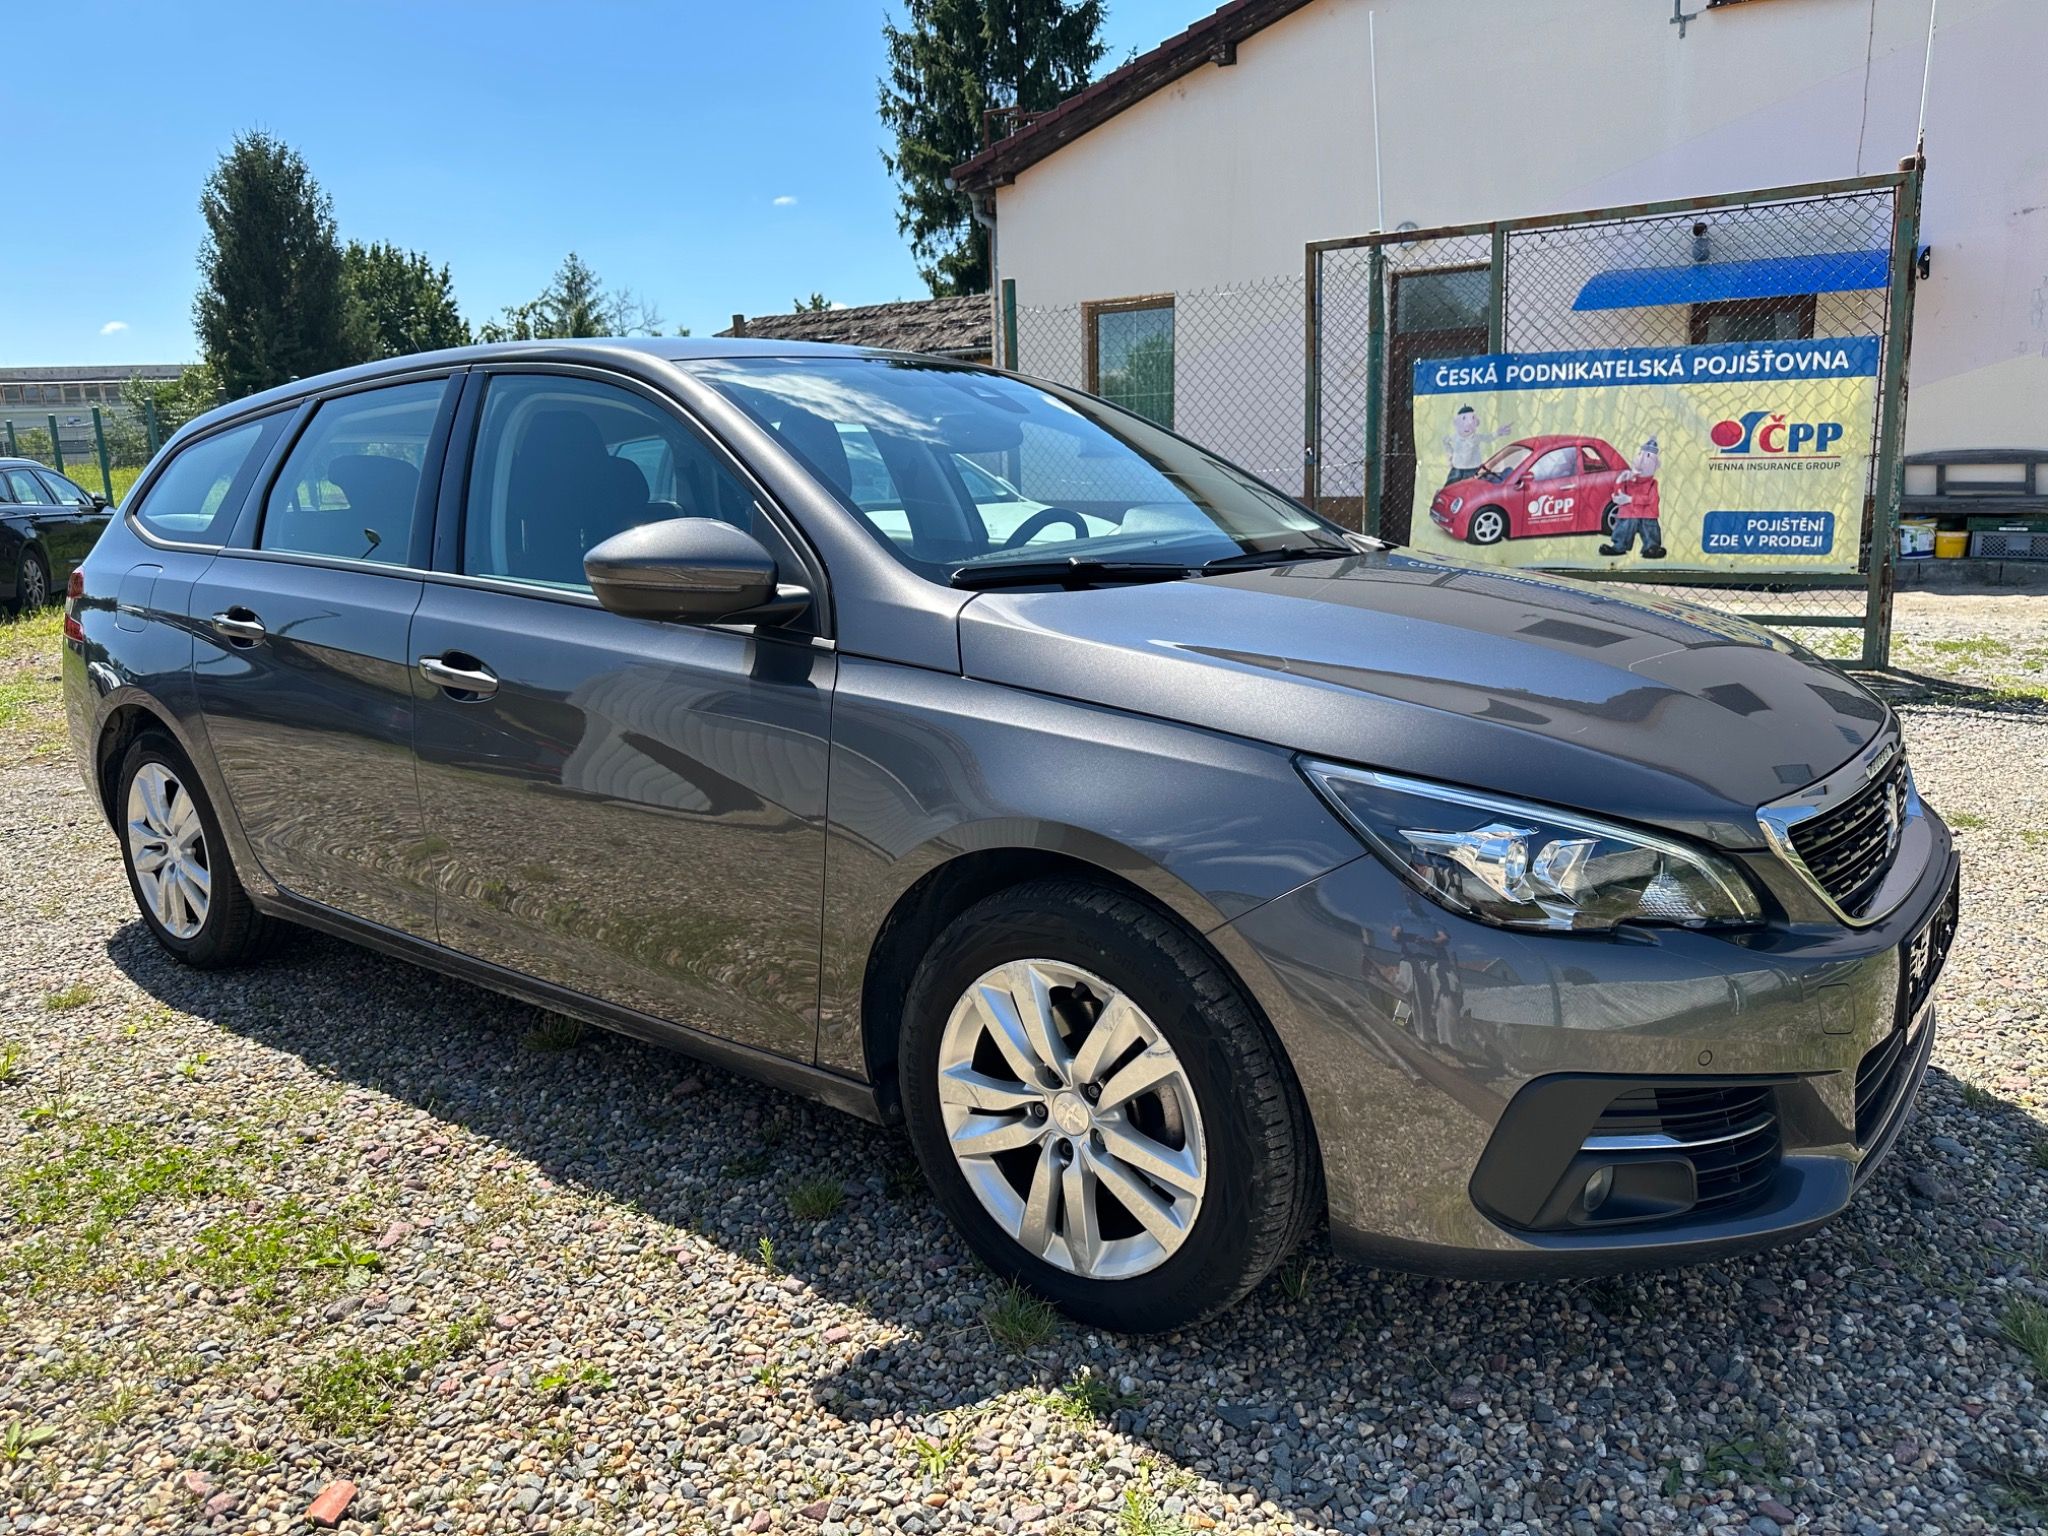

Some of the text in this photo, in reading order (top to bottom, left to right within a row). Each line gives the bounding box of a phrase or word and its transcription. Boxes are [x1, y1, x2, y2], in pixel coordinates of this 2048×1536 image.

[1435, 349, 1850, 387] ČESKÁ PODNIKATELSKÁ POJIŠŤOVNA
[1758, 414, 1844, 454] ČPP
[1707, 460, 1841, 472] VIENNA INSURANCE GROUP
[1543, 495, 1575, 515] ČPP
[1747, 517, 1826, 532] POJIŠTĚNÍ
[1708, 534, 1823, 548] ZDE V PRODEJI
